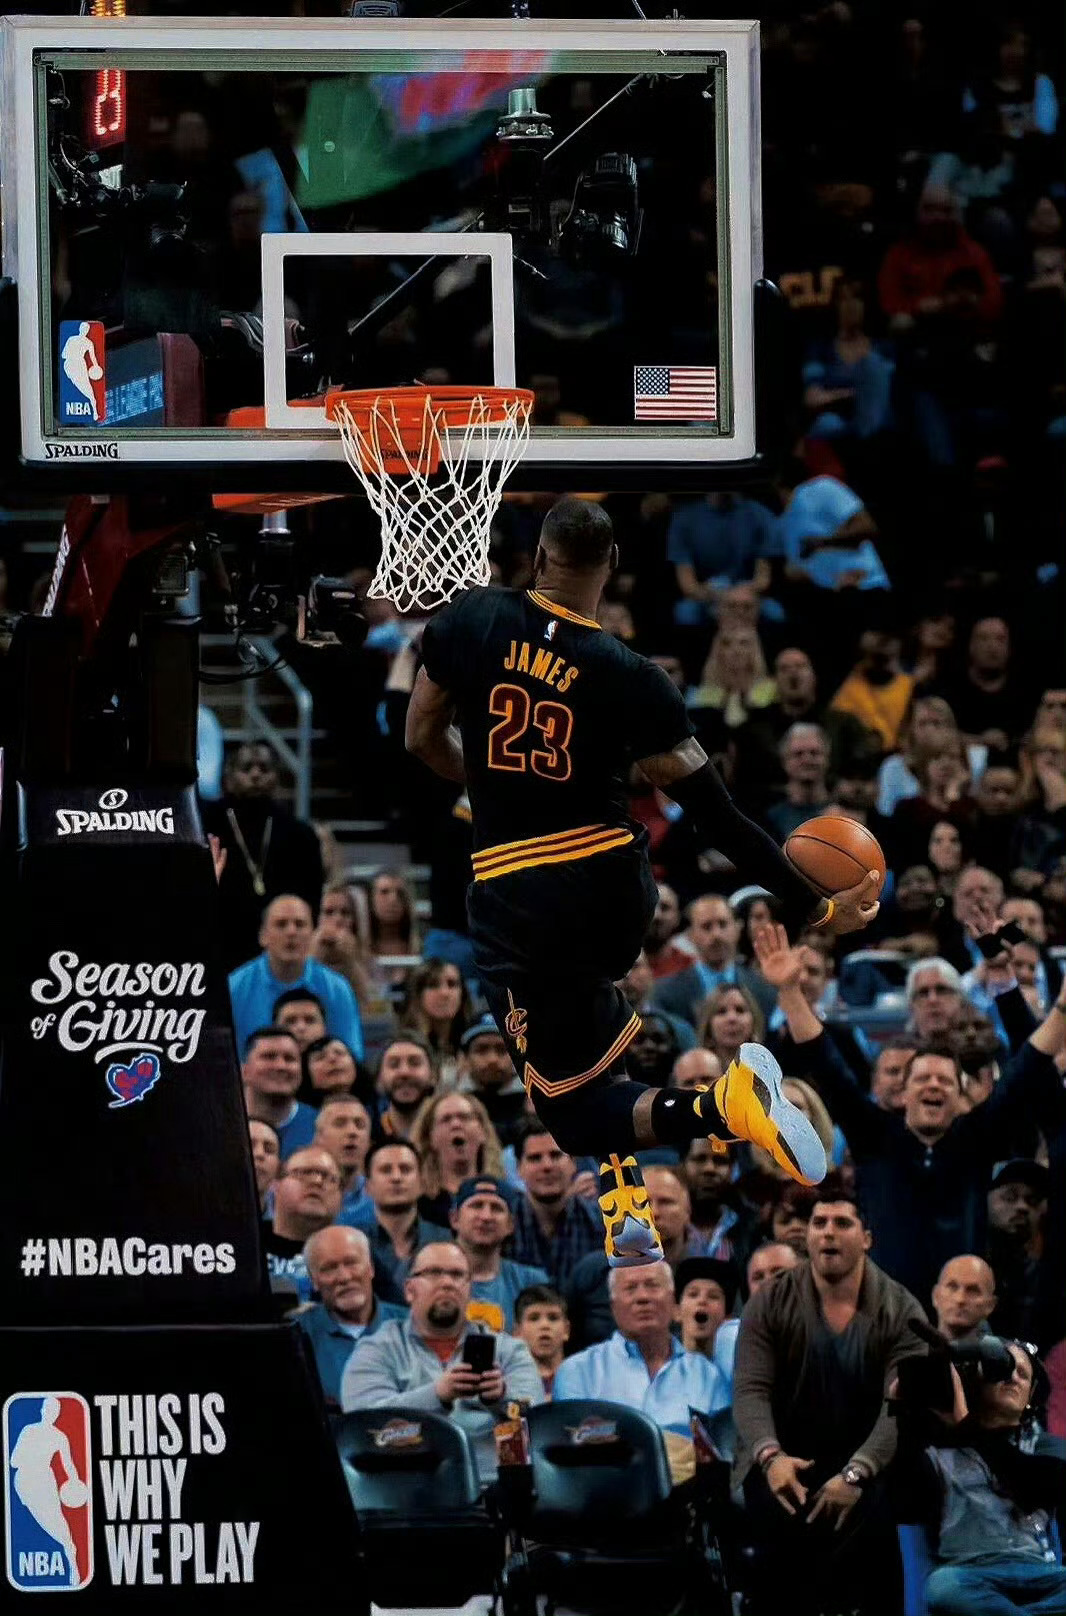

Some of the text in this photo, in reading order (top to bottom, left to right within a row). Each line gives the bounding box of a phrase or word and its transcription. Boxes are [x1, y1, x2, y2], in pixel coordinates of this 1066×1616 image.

[65, 402, 92, 416] NBA
[45, 443, 119, 459] SPALDING
[504, 640, 579, 693] JAMES
[487, 683, 574, 781] 23
[56, 807, 175, 836] SPALDING
[31, 950, 206, 1004] Season
[31, 1000, 207, 1063] of Giving
[21, 1237, 236, 1276] #NBACares
[94, 1392, 227, 1456] THIS IS
[99, 1458, 187, 1520] WHY
[19, 1551, 65, 1577] NBA
[104, 1522, 260, 1585] WE PLAY
